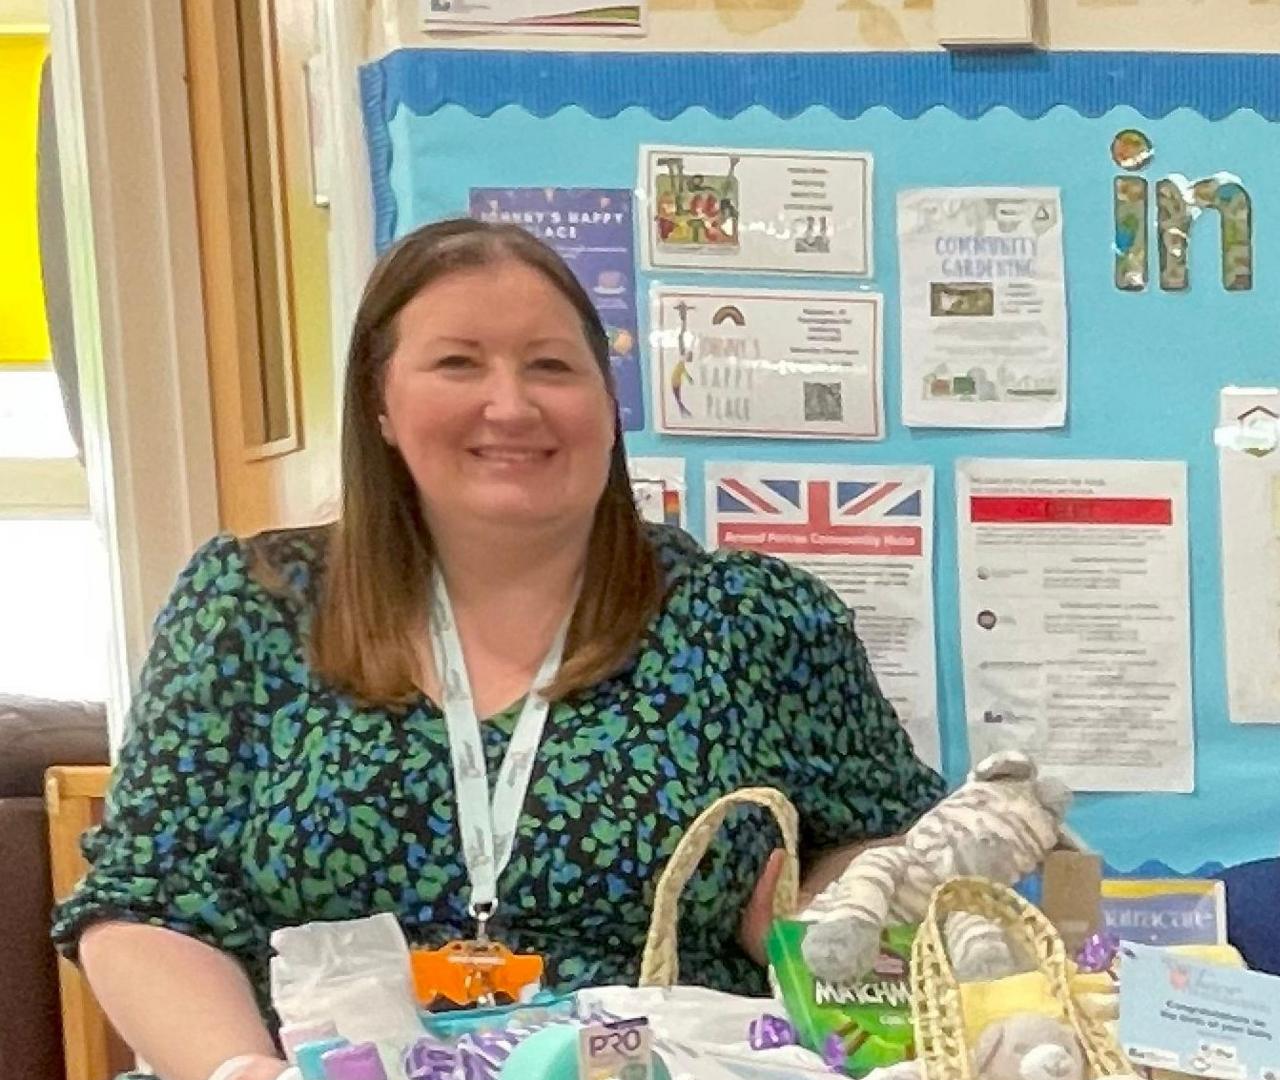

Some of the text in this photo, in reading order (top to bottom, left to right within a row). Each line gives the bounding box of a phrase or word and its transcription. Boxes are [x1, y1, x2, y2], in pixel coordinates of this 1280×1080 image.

[567, 211, 624, 224] HAPPY
[1111, 128, 1254, 291] in
[815, 980, 913, 1007] MATCHM
[588, 1028, 642, 1058] PRO
